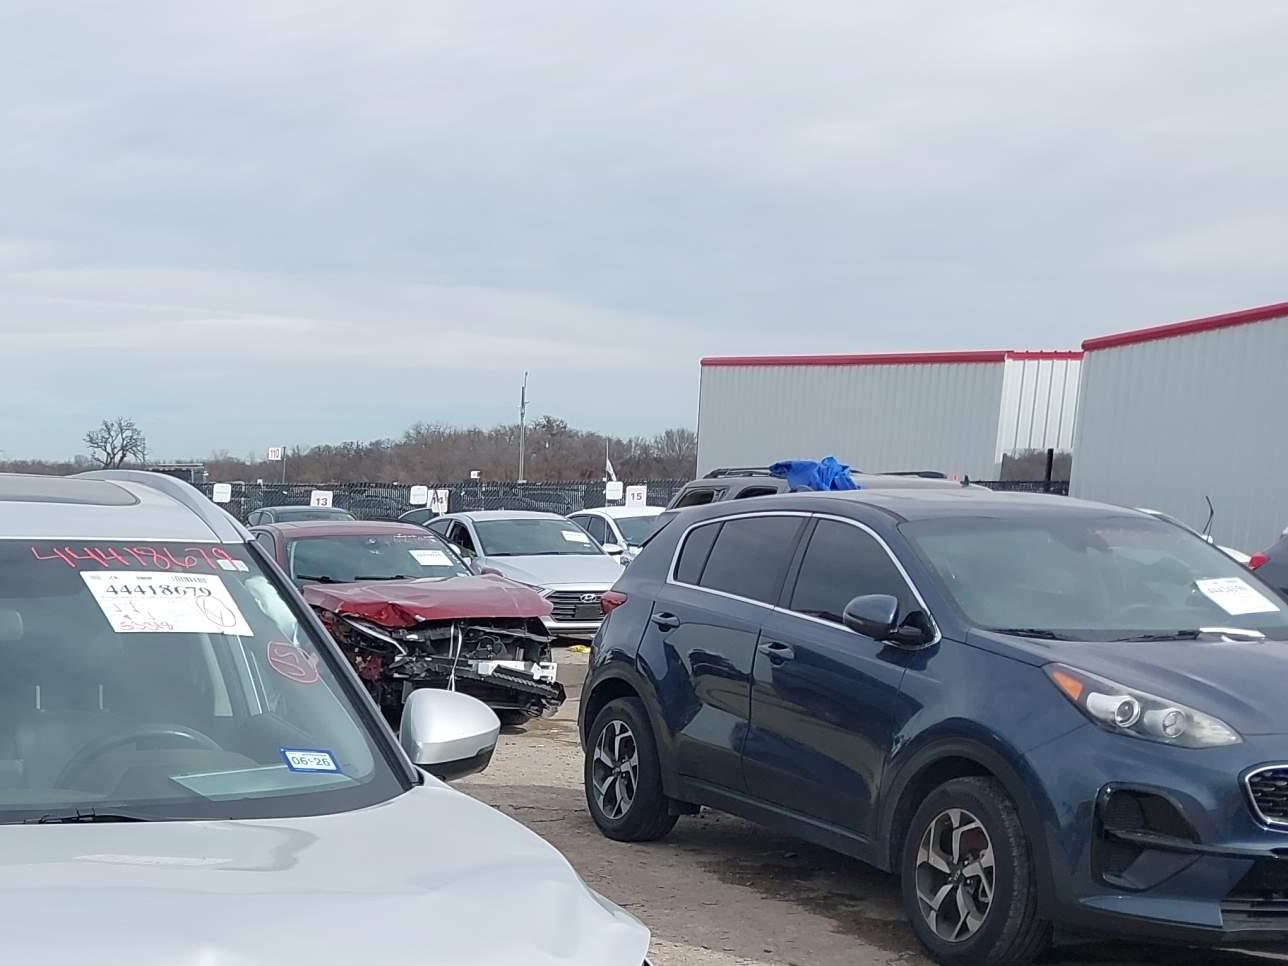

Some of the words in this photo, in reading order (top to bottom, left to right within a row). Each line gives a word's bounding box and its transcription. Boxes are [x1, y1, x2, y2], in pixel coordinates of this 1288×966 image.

[630, 492, 643, 501] 15
[316, 497, 328, 506] 13
[105, 584, 212, 598] 44418679
